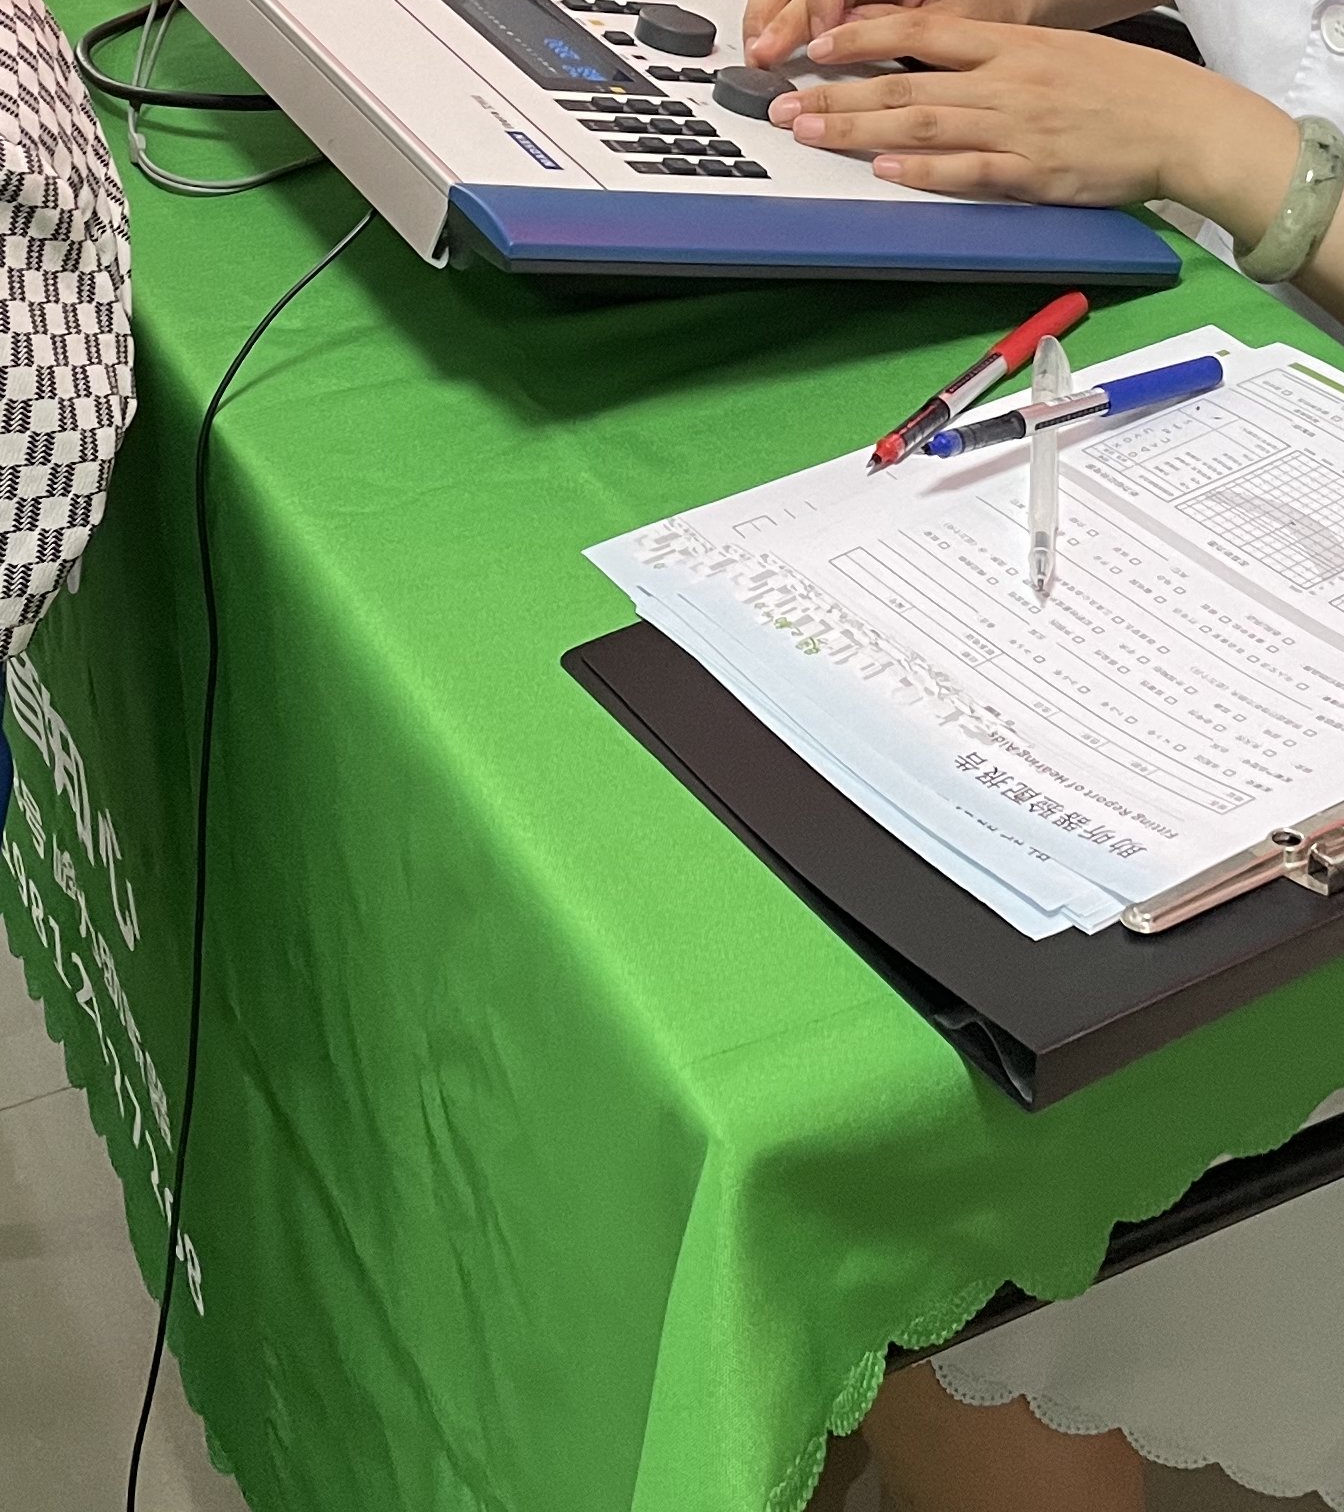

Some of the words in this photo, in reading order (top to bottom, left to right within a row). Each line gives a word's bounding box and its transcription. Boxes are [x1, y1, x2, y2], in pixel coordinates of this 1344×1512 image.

[1016, 748, 1070, 782] Hearing
[954, 752, 1147, 859] 助听器验配报告
[1082, 788, 1133, 818] Report
[1132, 811, 1179, 840] Fitting
